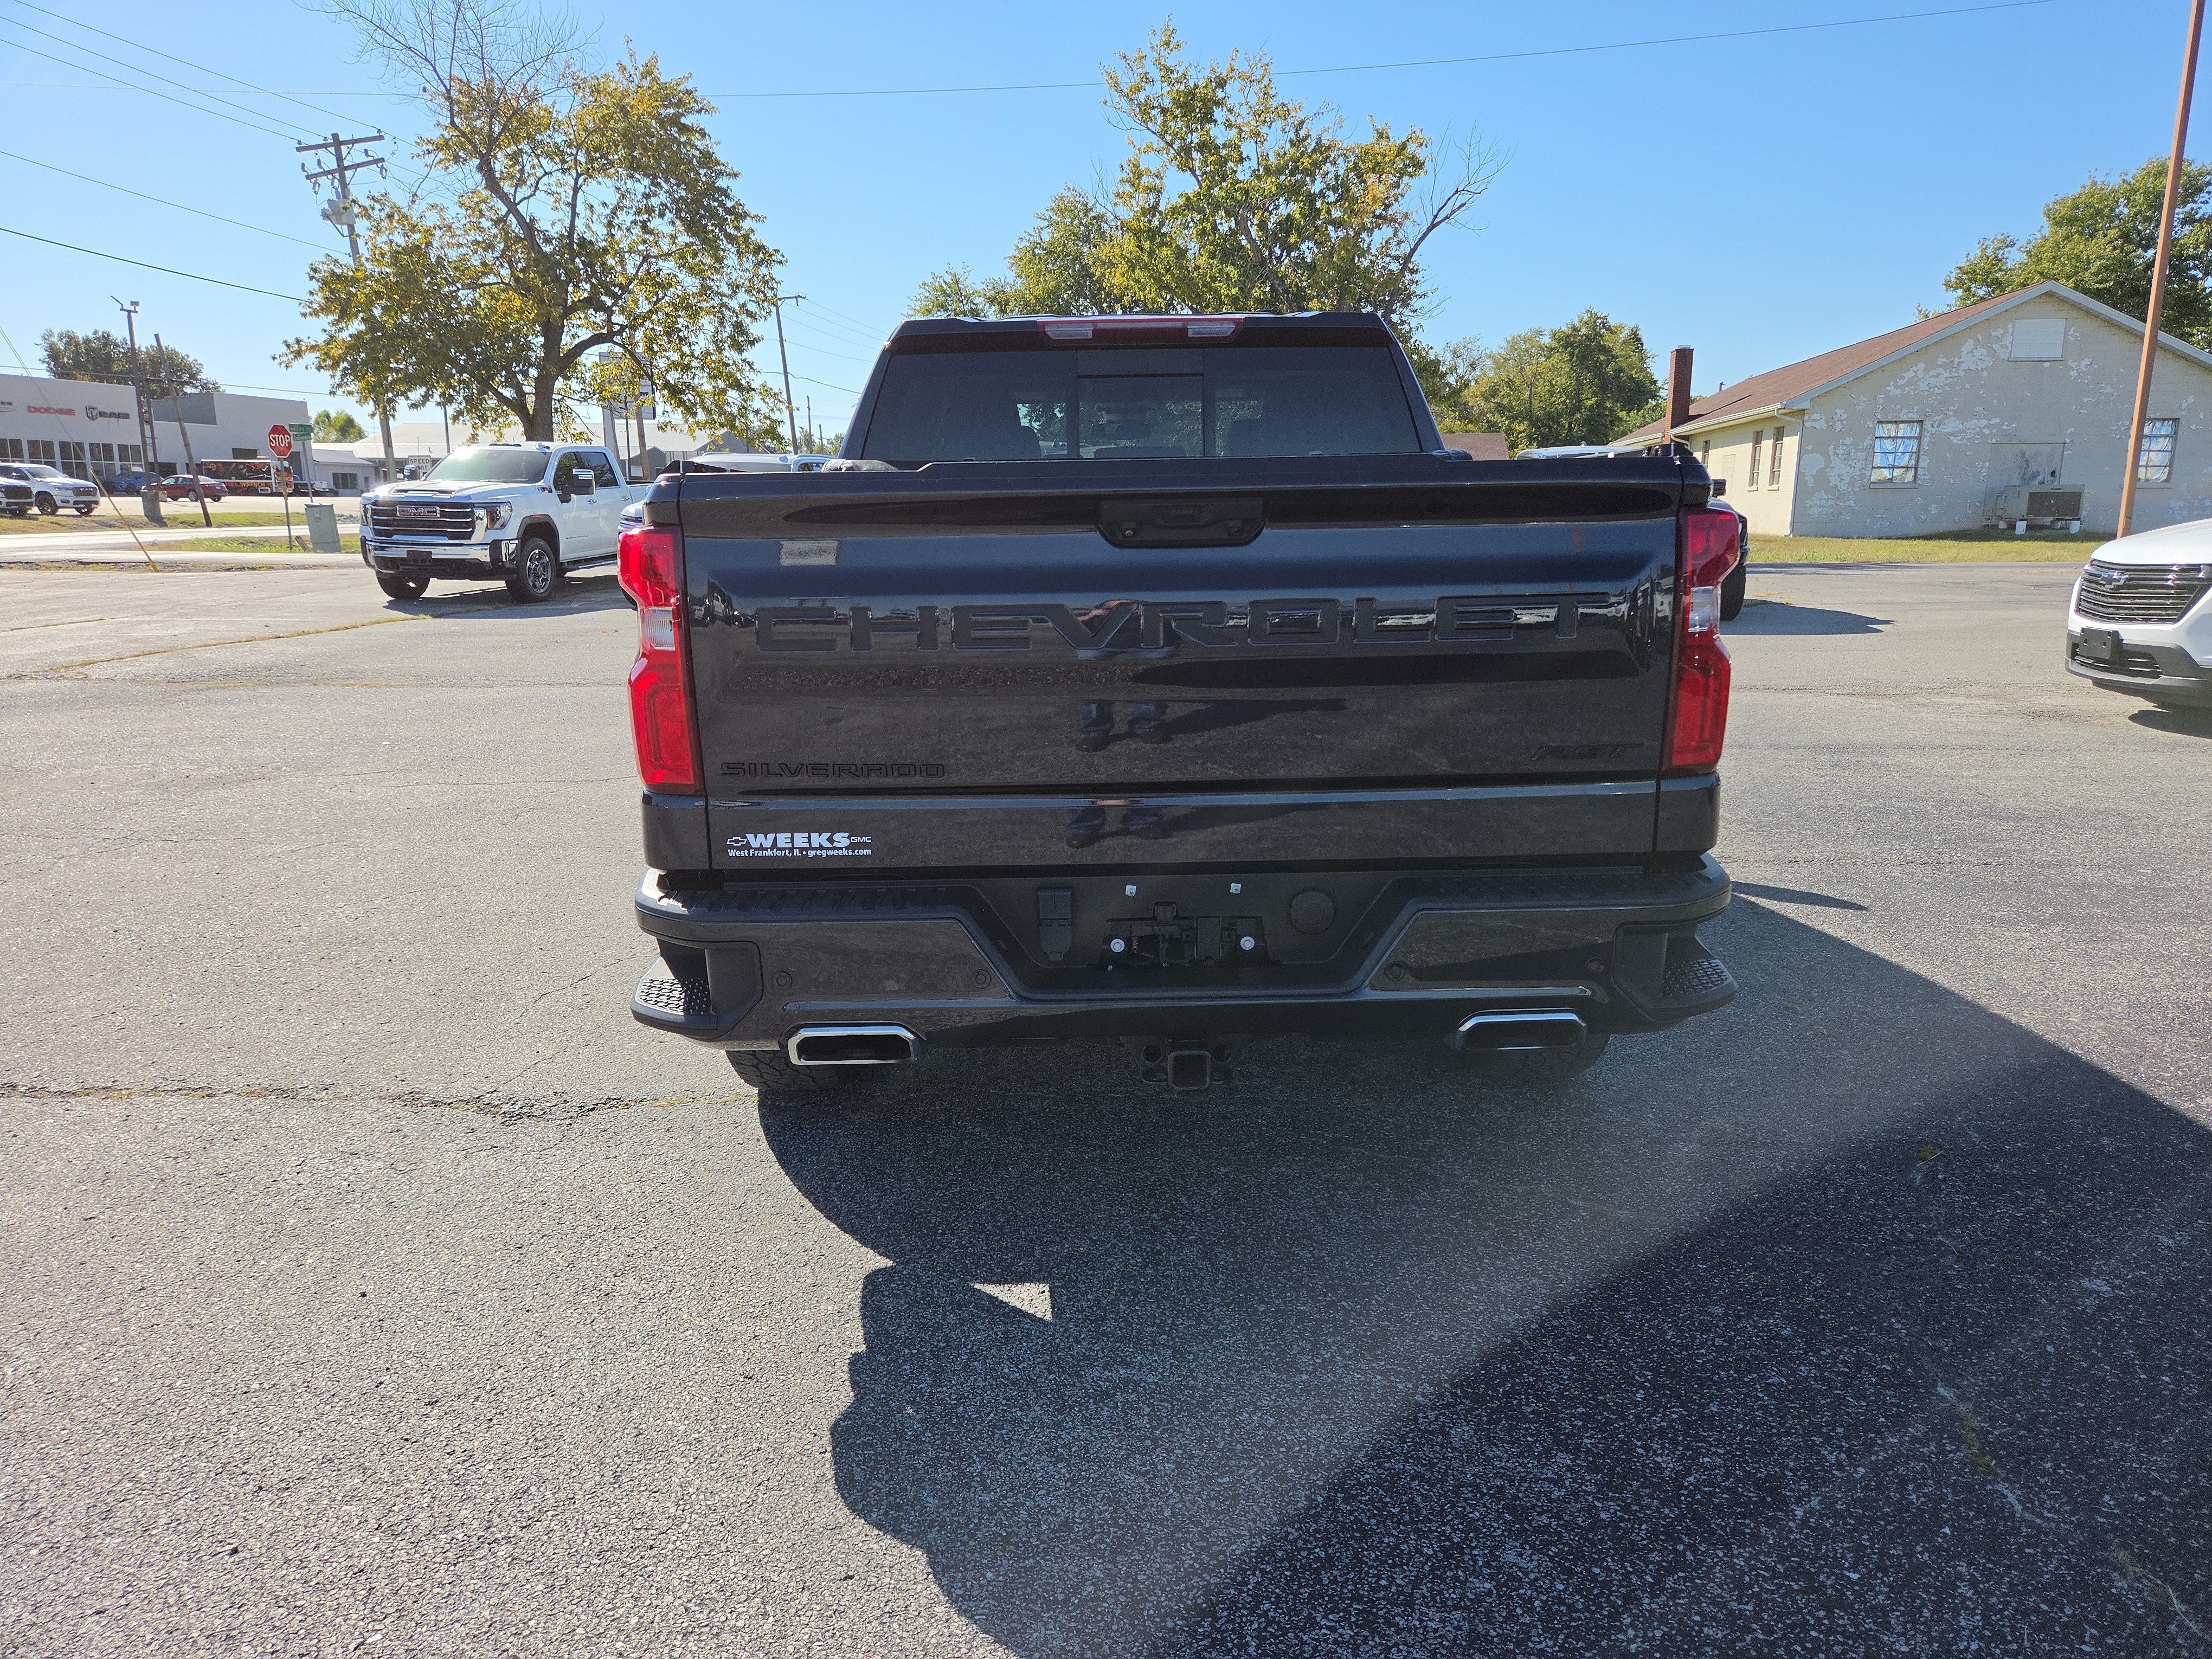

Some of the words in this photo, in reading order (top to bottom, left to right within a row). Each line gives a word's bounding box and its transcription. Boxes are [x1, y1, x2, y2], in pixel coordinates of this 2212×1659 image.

[269, 434, 290, 447] STOP
[398, 507, 436, 516] GMC
[755, 591, 1612, 652] CHEVROLET
[721, 762, 945, 778] SILVERADO
[745, 832, 850, 848] WEEKS
[749, 849, 792, 857] Frankfort,
[807, 848, 872, 858] gregweeks.com
